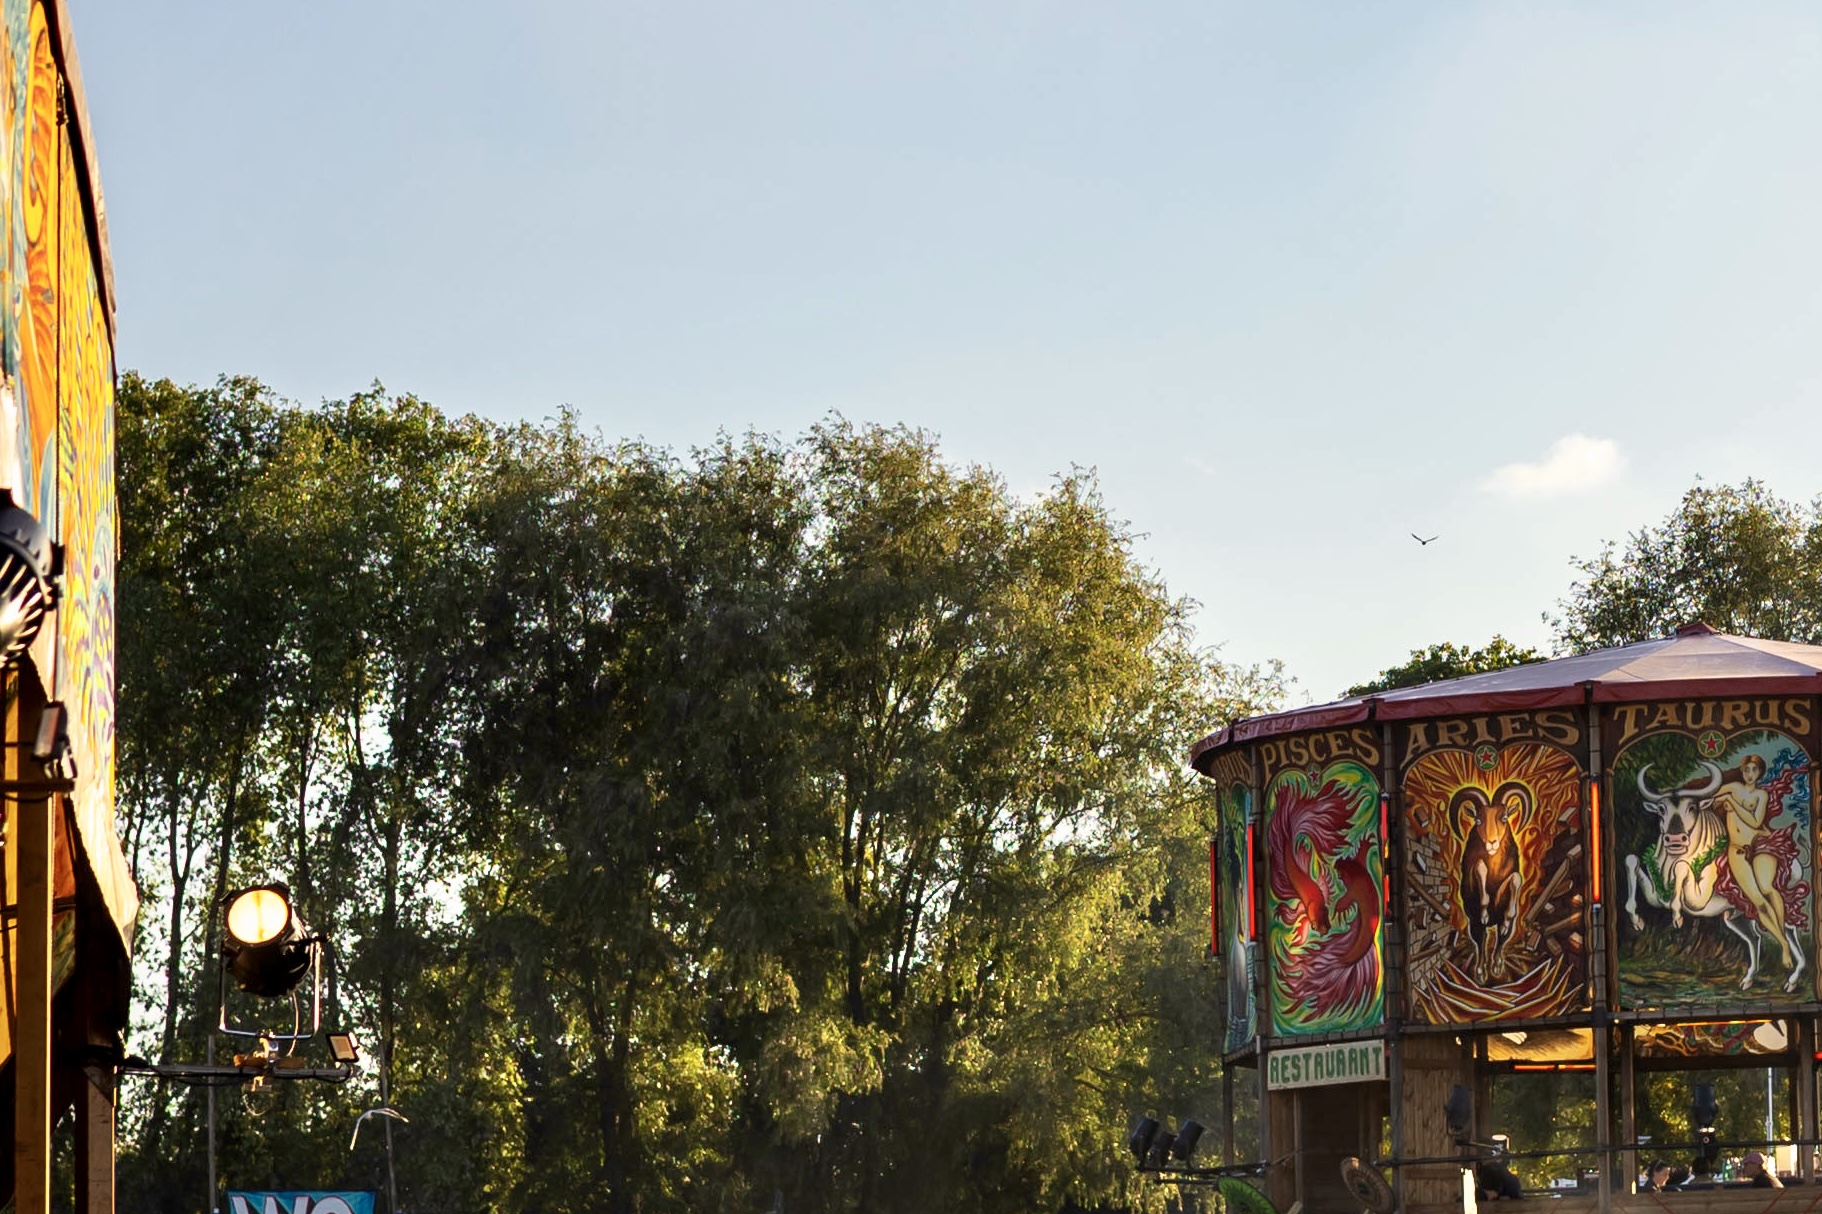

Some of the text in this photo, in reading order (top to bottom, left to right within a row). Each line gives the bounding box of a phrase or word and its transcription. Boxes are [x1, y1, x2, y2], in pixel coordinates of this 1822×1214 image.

[1400, 710, 1580, 770] ARIES
[1612, 697, 1811, 746] TAURUS
[1260, 727, 1380, 790] PISCES
[1269, 1046, 1382, 1084] RESTAURANT
